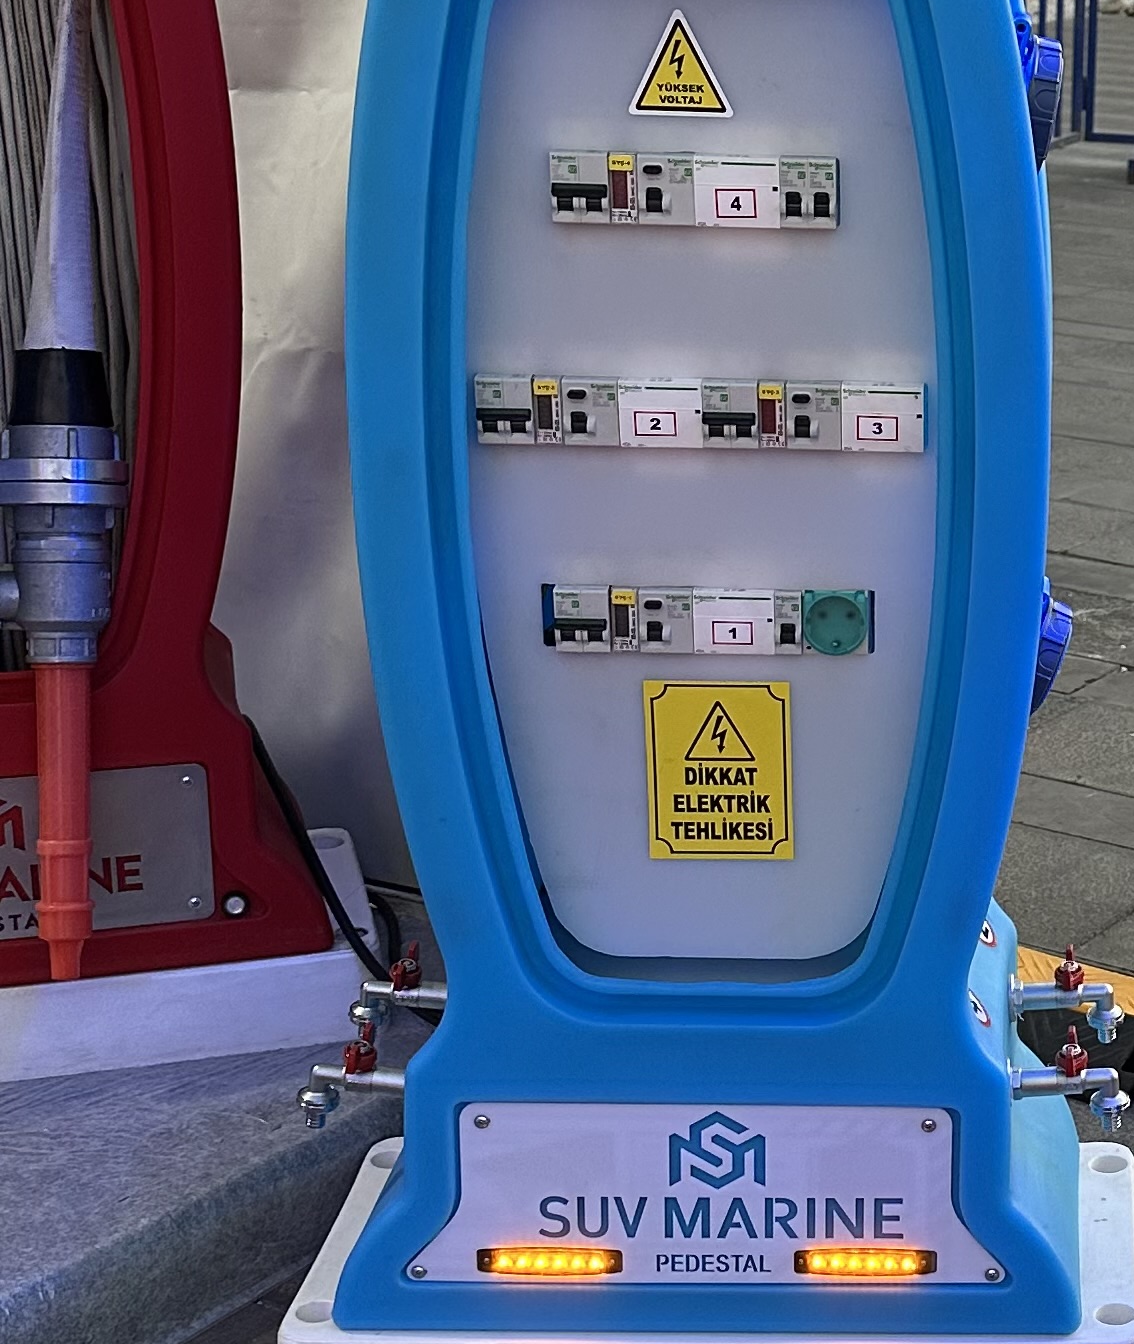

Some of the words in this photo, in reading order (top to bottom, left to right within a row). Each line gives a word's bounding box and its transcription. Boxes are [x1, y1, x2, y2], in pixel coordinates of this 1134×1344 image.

[656, 81, 705, 93] YÜKSEK
[659, 94, 703, 105] VOLTAJ
[730, 196, 742, 211] 4
[649, 417, 662, 431] 2
[871, 422, 883, 435] 3
[728, 627, 737, 640] 1
[684, 762, 757, 786] DİKKAT
[672, 790, 771, 814] ELEKTRİK
[670, 817, 774, 841] TEHLİKESİ
[538, 1195, 648, 1239] SUV
[664, 1196, 904, 1240] MARINE
[655, 1252, 772, 1274] PEDESTAL
